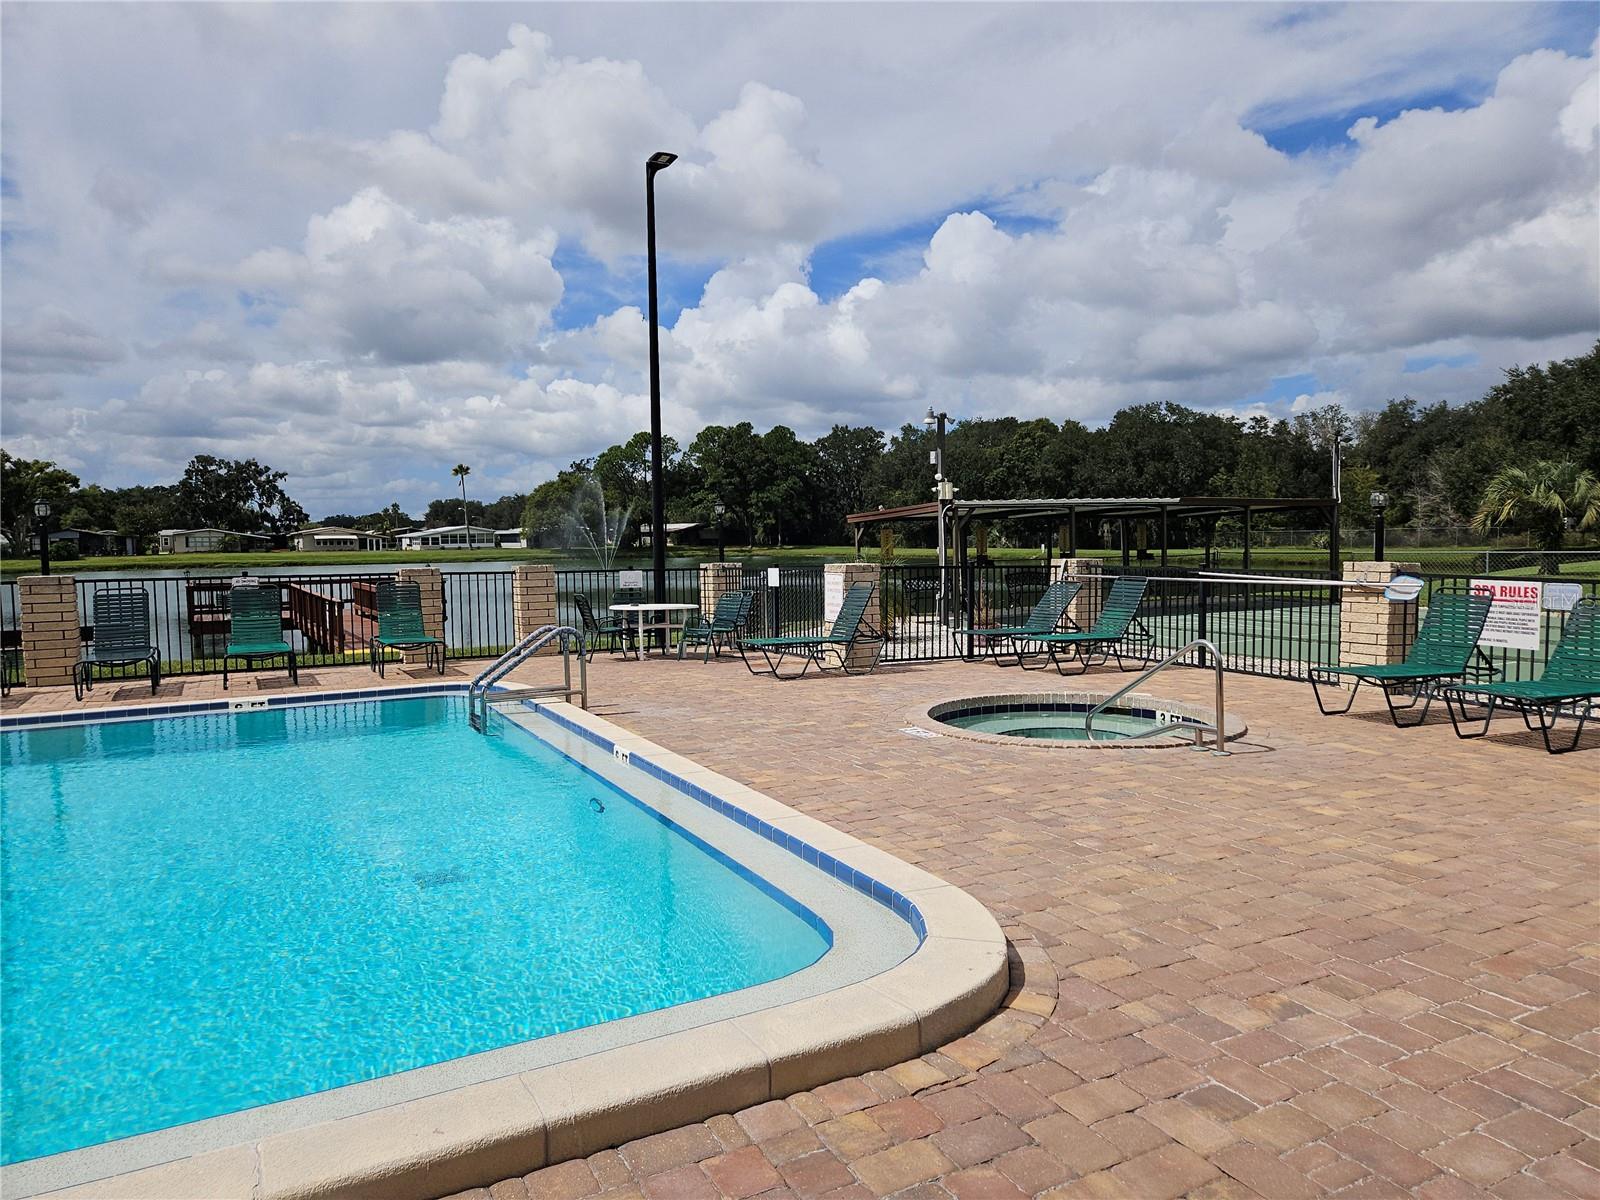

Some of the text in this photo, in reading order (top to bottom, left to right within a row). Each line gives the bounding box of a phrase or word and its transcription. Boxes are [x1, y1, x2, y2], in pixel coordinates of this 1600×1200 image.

[1473, 584, 1496, 597] SPA
[1500, 585, 1538, 599] RULES
[1160, 712, 1181, 723] 3 FT
